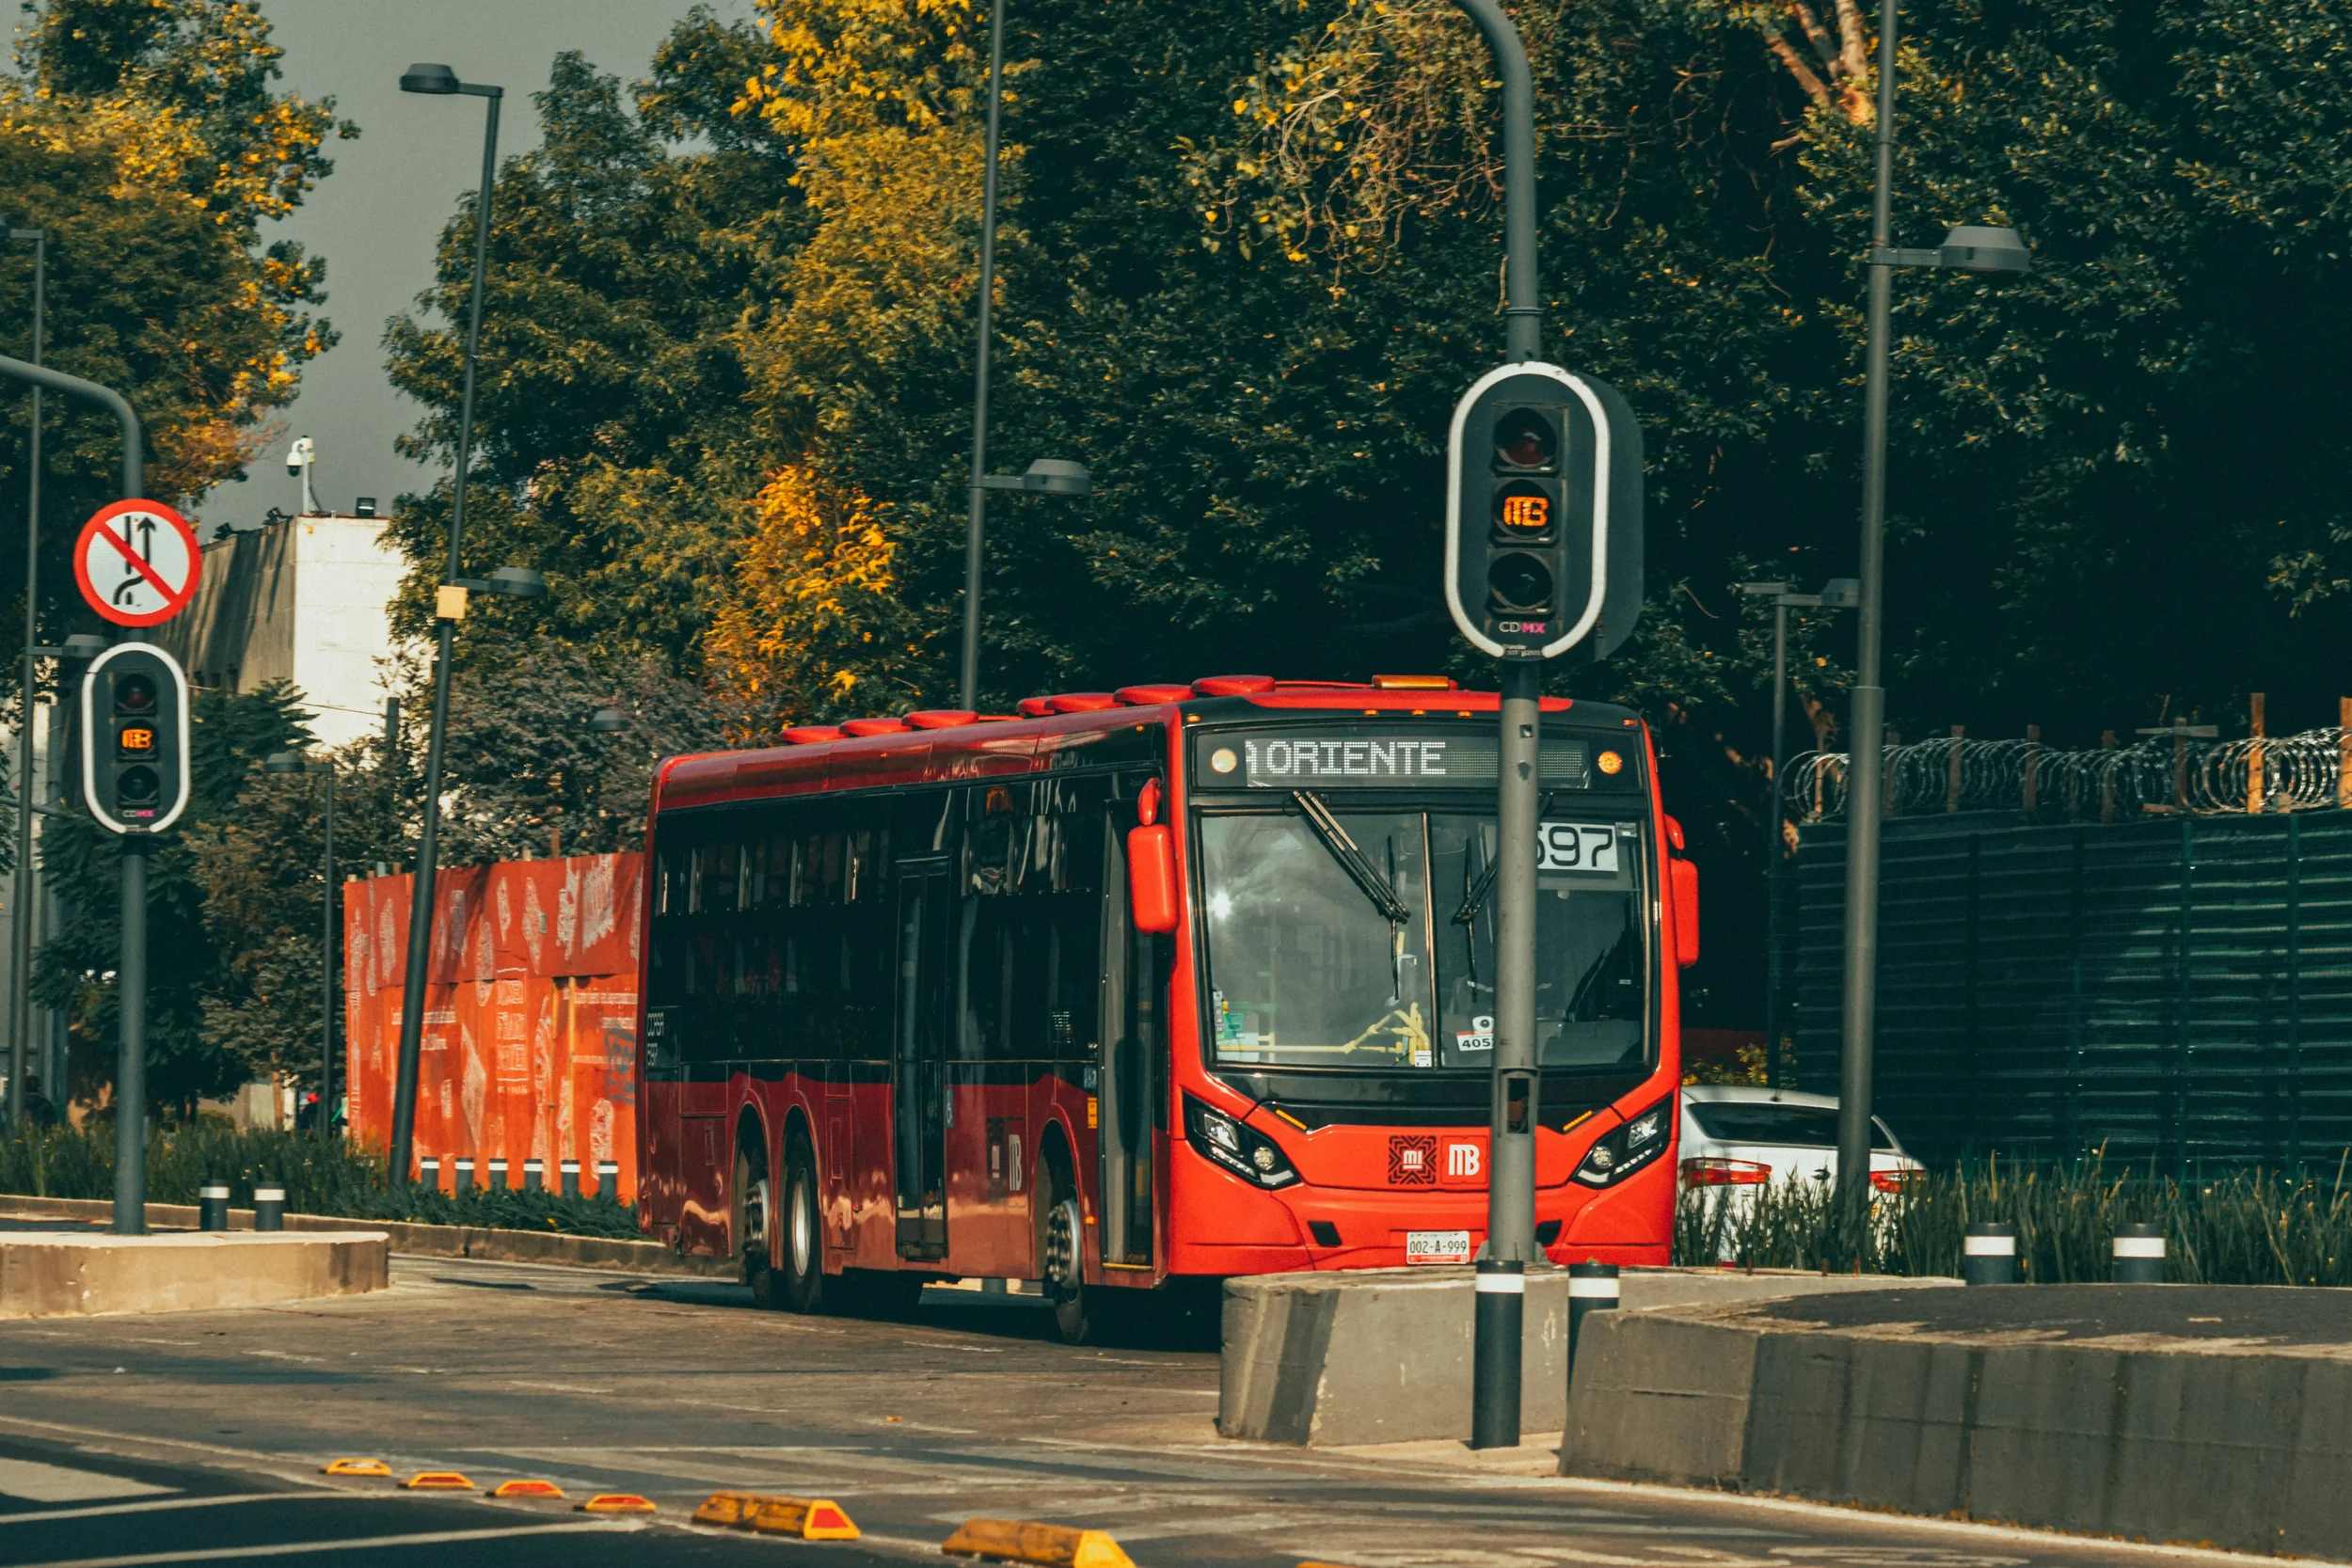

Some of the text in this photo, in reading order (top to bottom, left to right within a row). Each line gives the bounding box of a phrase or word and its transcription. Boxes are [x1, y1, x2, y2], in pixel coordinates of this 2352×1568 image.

[1499, 622, 1546, 633] CDMX
[1266, 741, 1446, 774] ORIENTE
[1462, 1038, 1494, 1048] 405
[1449, 1144, 1480, 1176] MB
[1409, 1241, 1467, 1254] 002-A-999
